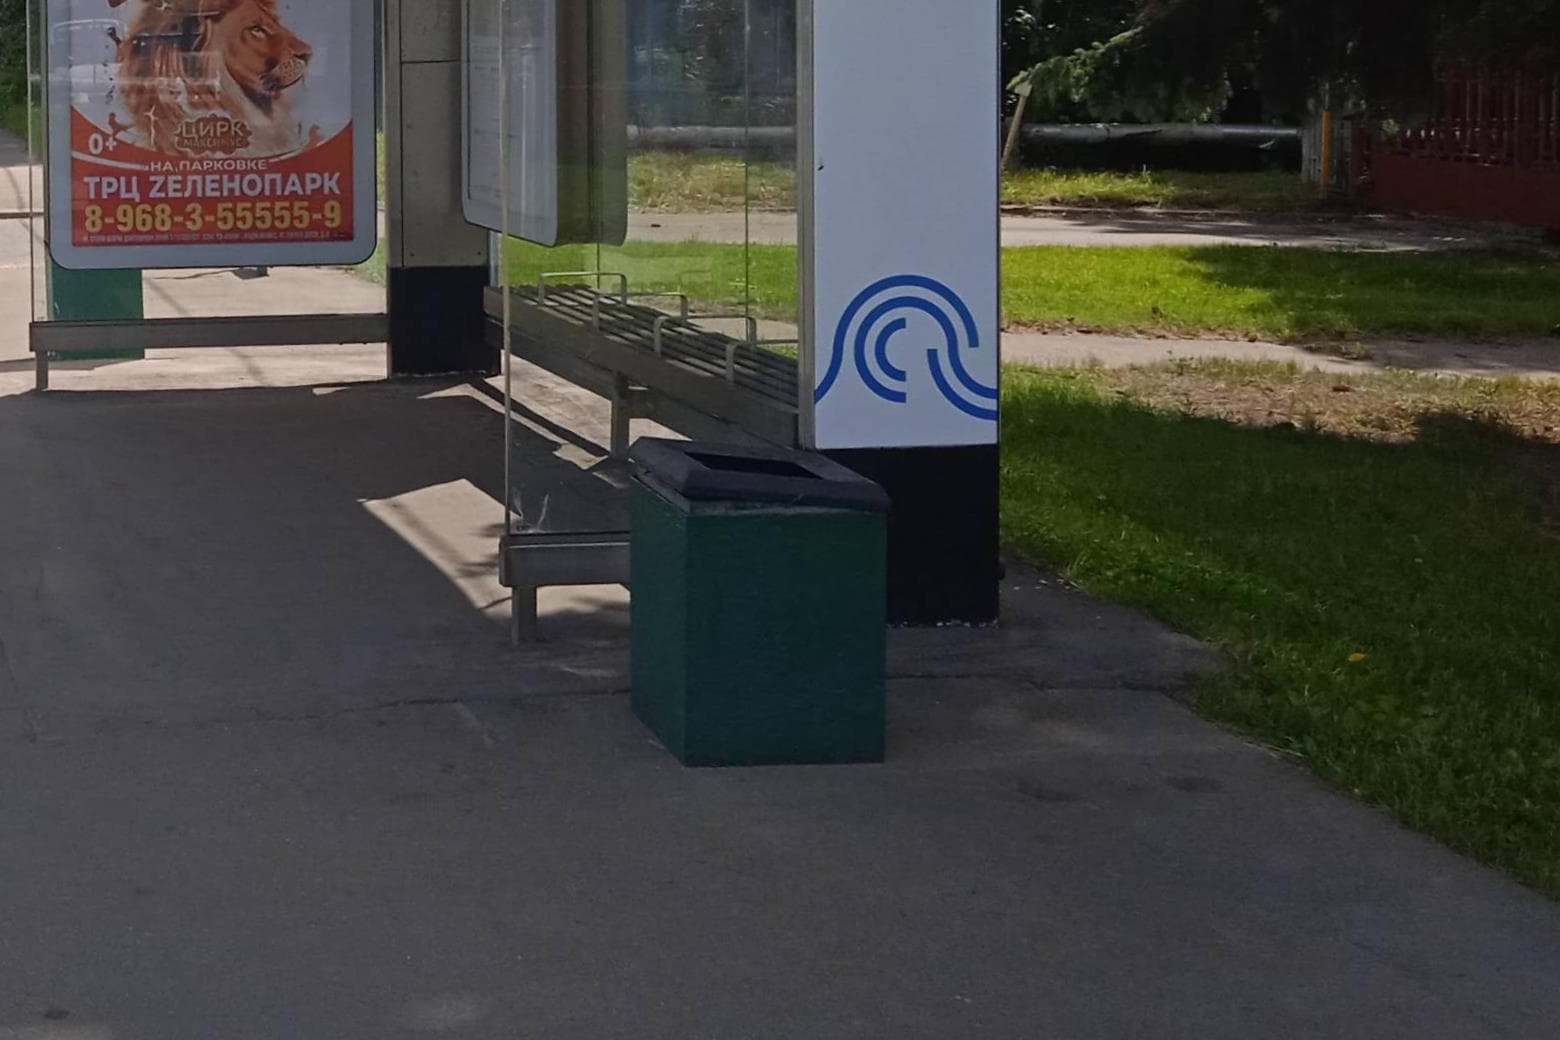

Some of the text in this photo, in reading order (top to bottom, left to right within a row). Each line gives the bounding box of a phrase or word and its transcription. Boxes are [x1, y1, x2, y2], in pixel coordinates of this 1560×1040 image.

[182, 120, 244, 138] ЦИРК
[88, 133, 117, 155] 0+
[181, 159, 268, 172] ПАРКОВКЕ
[83, 171, 340, 202] ТРЦ ZЕЛЕНОПАРК
[84, 200, 341, 233] 8-968-3-55555-9
